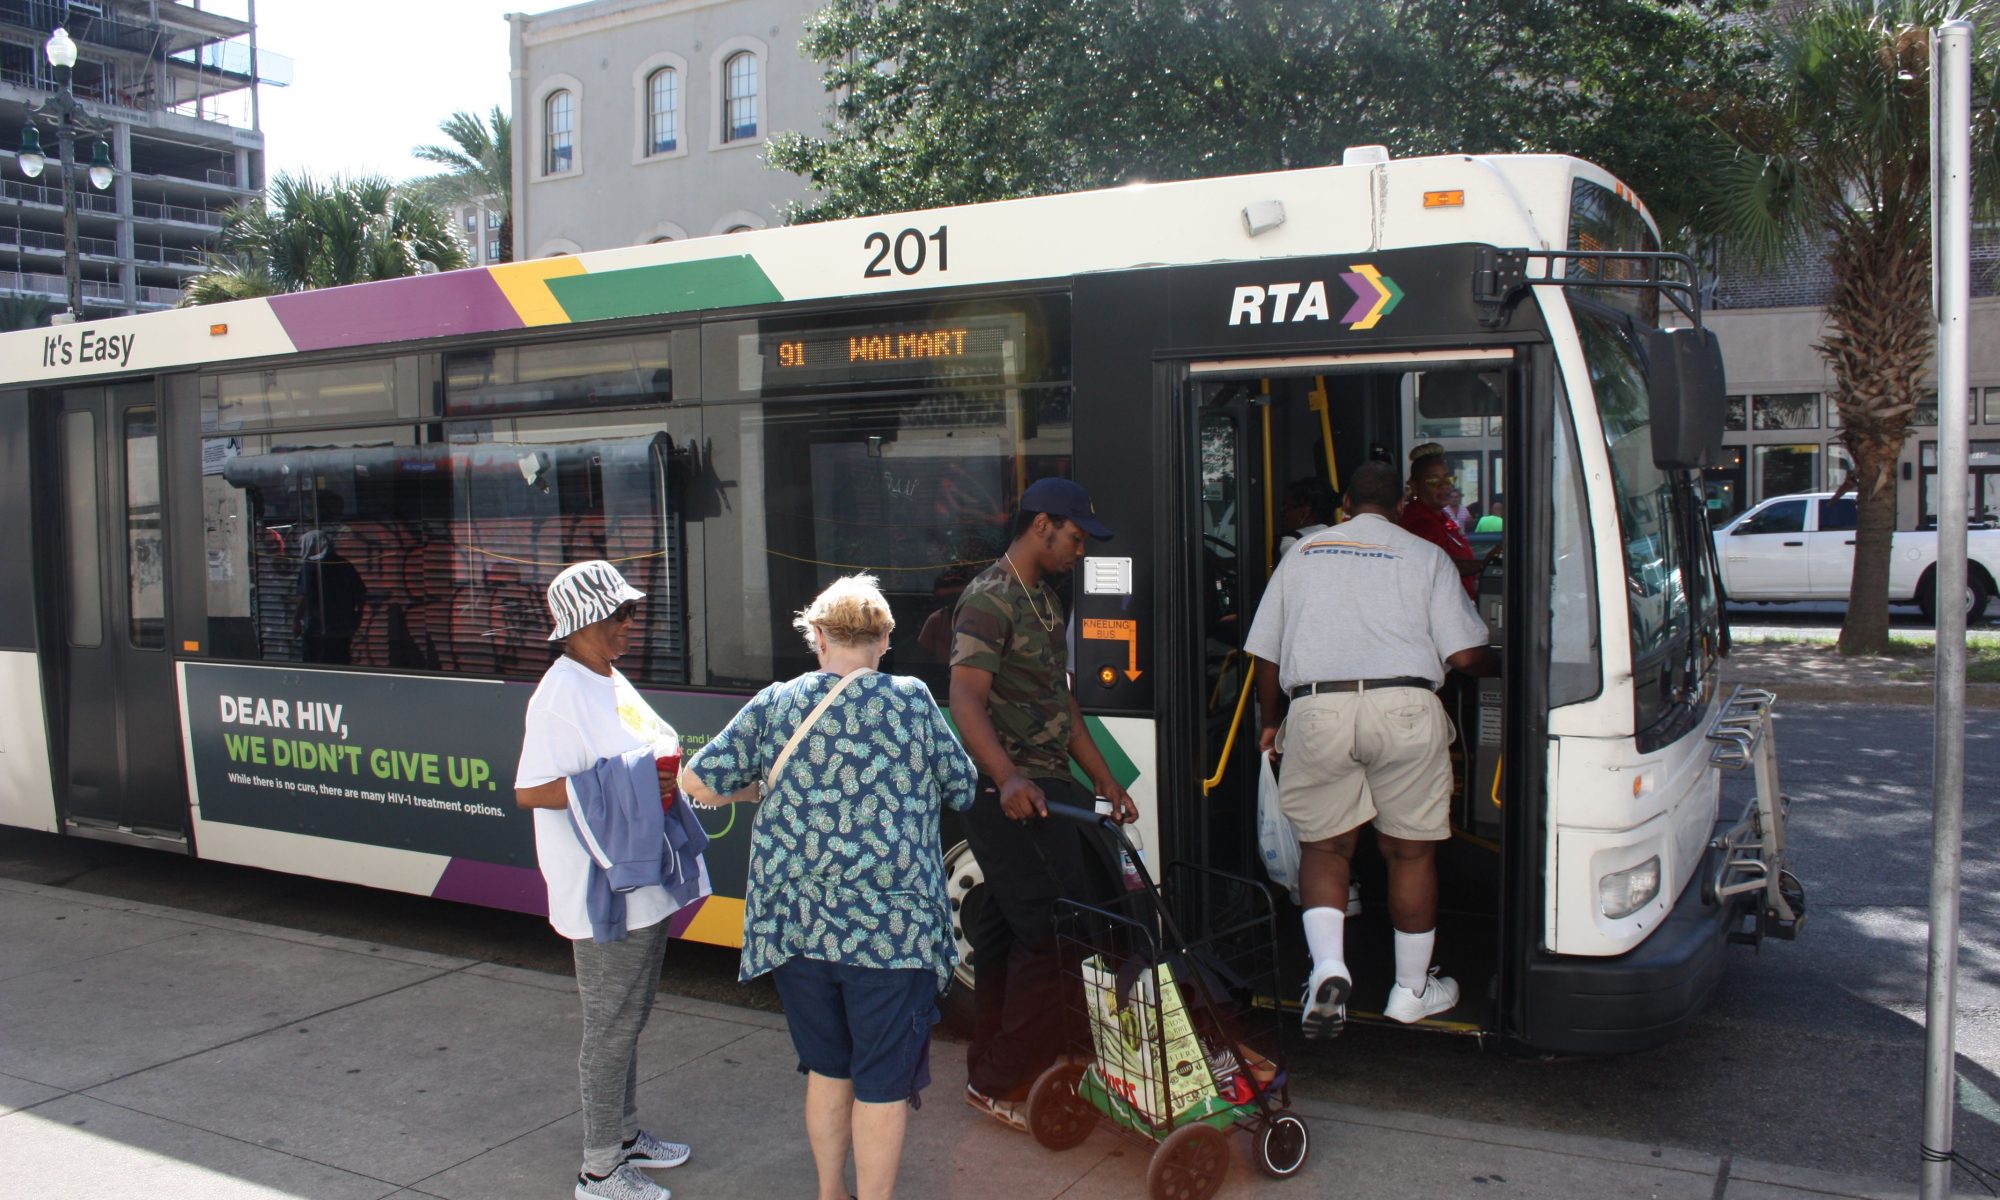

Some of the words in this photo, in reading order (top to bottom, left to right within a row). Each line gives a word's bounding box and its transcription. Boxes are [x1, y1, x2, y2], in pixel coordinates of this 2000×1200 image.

[864, 225, 947, 278] 201
[1229, 281, 1329, 326] RTA
[43, 334, 73, 368] It's
[80, 330, 136, 368] Easy
[779, 342, 805, 367] 91
[850, 328, 967, 362] WALMART
[1083, 619, 1130, 630] KNEELING
[1096, 629, 1116, 639] BUS
[220, 695, 290, 729] DEAR
[296, 701, 349, 740] HIV,
[687, 733, 705, 744] and
[224, 733, 268, 765] WE
[370, 748, 441, 785] GIVE
[447, 756, 497, 791] UP.
[228, 772, 251, 786] While
[252, 775, 275, 788] there
[275, 777, 283, 789] is
[284, 780, 296, 791] no
[297, 781, 319, 796] cure,
[319, 783, 343, 798] there
[344, 787, 359, 799] are
[361, 789, 386, 804] many
[387, 793, 412, 806] HIV-1
[413, 796, 461, 812] treatment
[464, 801, 505, 817] options.
